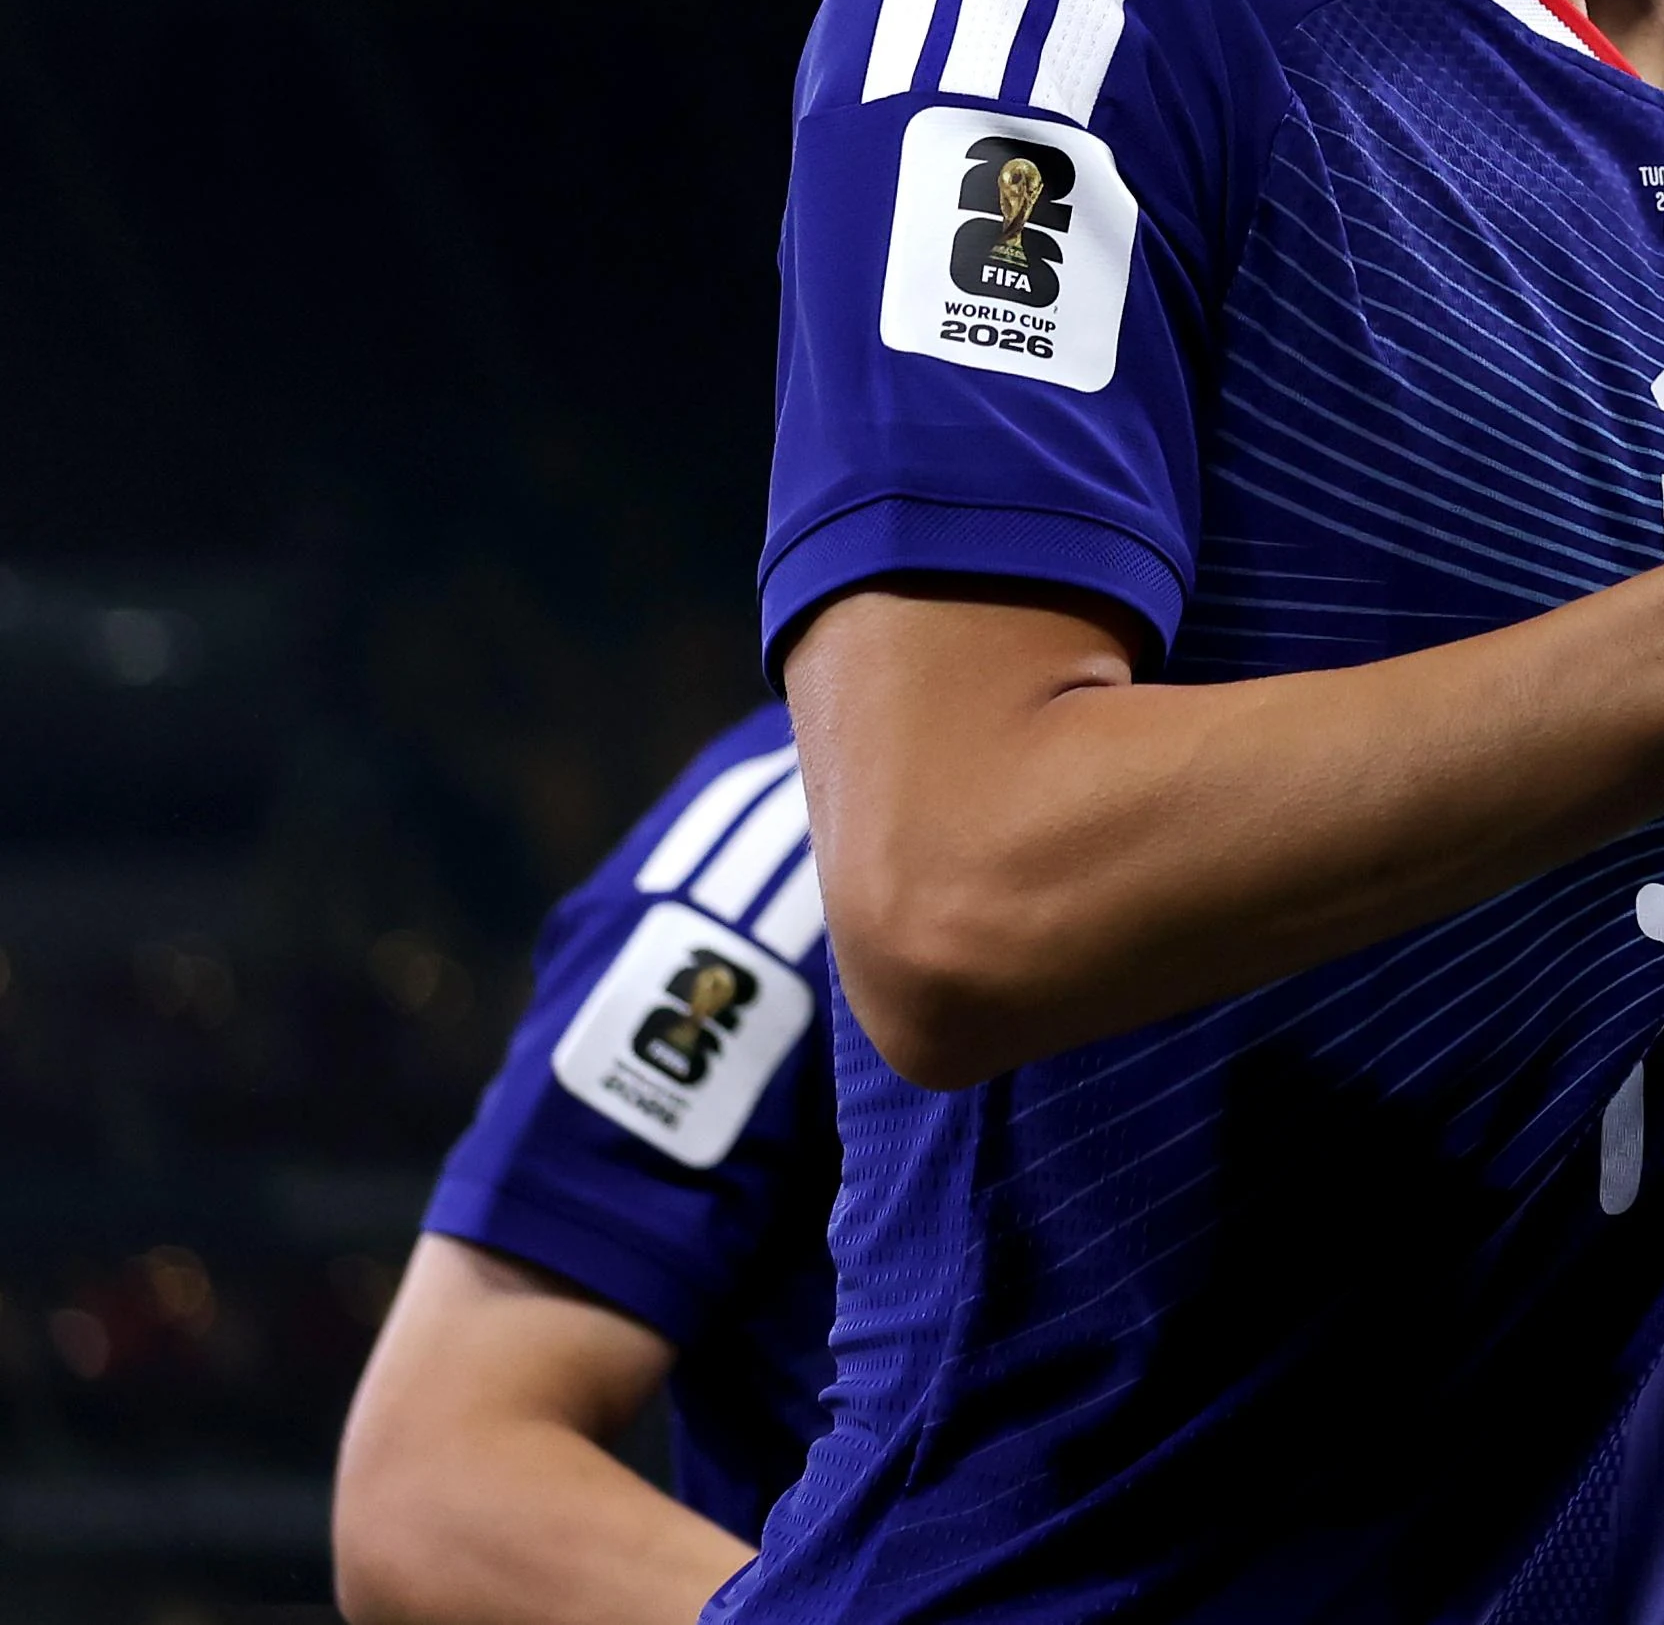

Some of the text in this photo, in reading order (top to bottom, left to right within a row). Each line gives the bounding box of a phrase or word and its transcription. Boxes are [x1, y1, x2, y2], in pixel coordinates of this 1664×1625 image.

[981, 264, 1032, 293] FIFA
[945, 301, 1057, 333] WORLD CUP
[940, 320, 1054, 359] 2026
